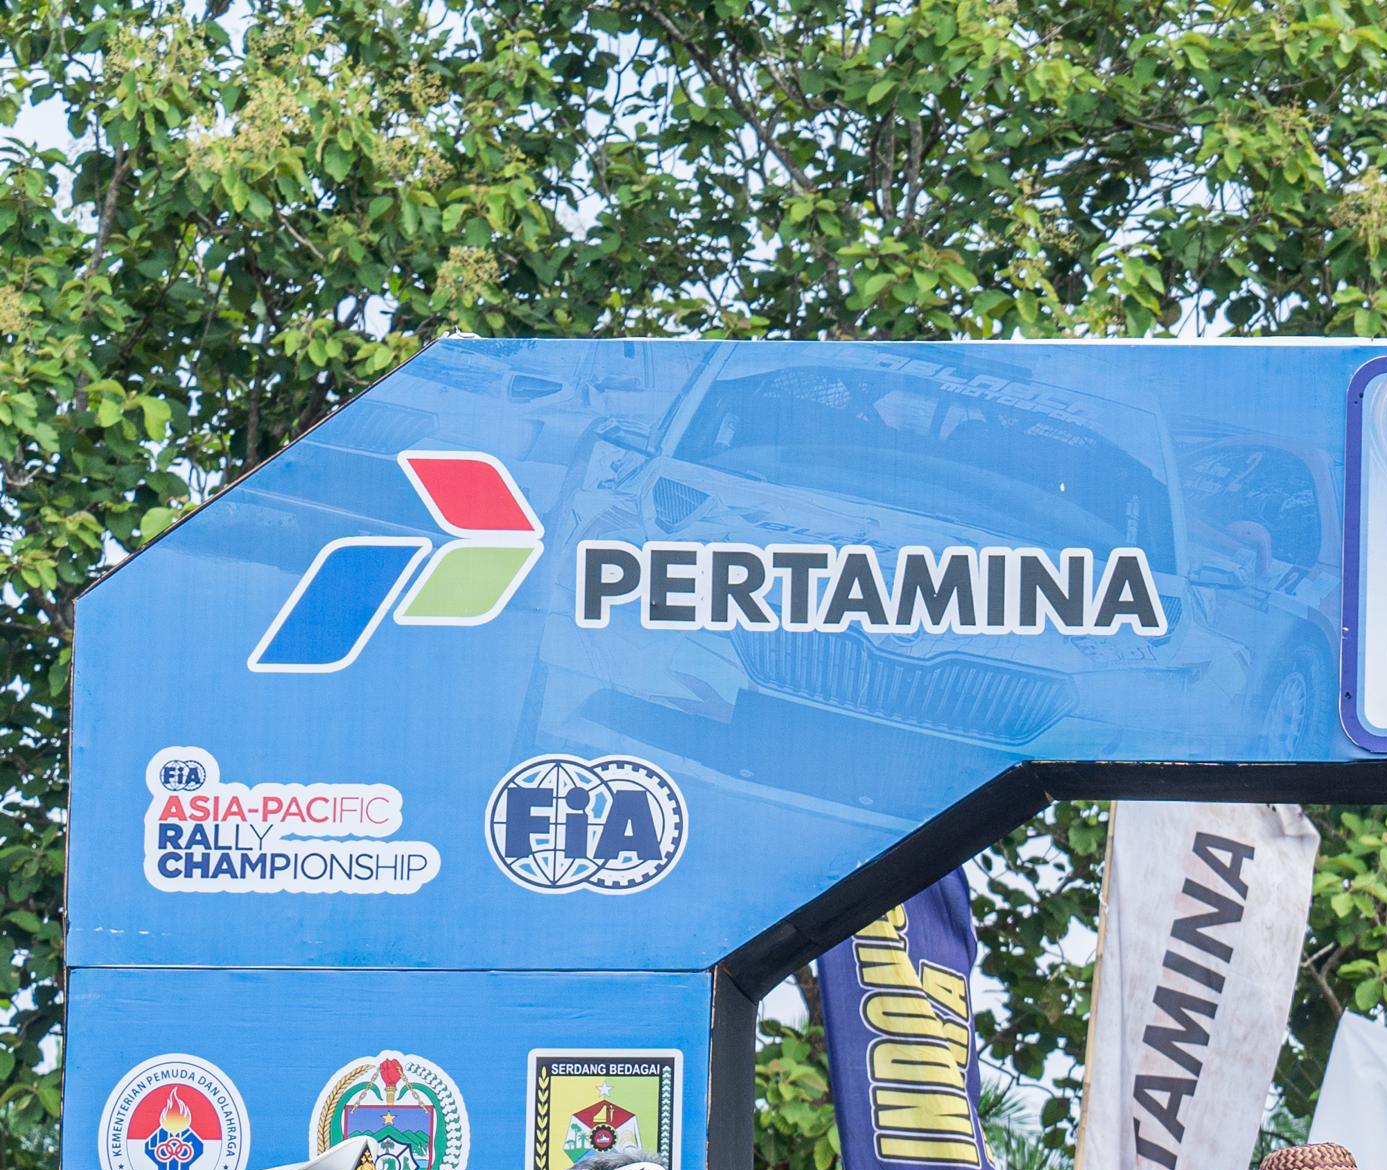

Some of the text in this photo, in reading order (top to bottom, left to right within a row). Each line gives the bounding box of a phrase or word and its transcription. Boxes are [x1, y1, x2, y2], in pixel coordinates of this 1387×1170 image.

[583, 547, 1161, 630] PERTAMINA
[157, 794, 392, 825] ASIA-PACIFIC
[157, 822, 275, 852] RALLY
[157, 851, 429, 882] CHAMPIONSHIP
[550, 1063, 661, 1076] SERDANG BEDAGAI
[112, 1068, 237, 1158] KEMENTERIAN PEMUDA DAN OLAHRAGA
